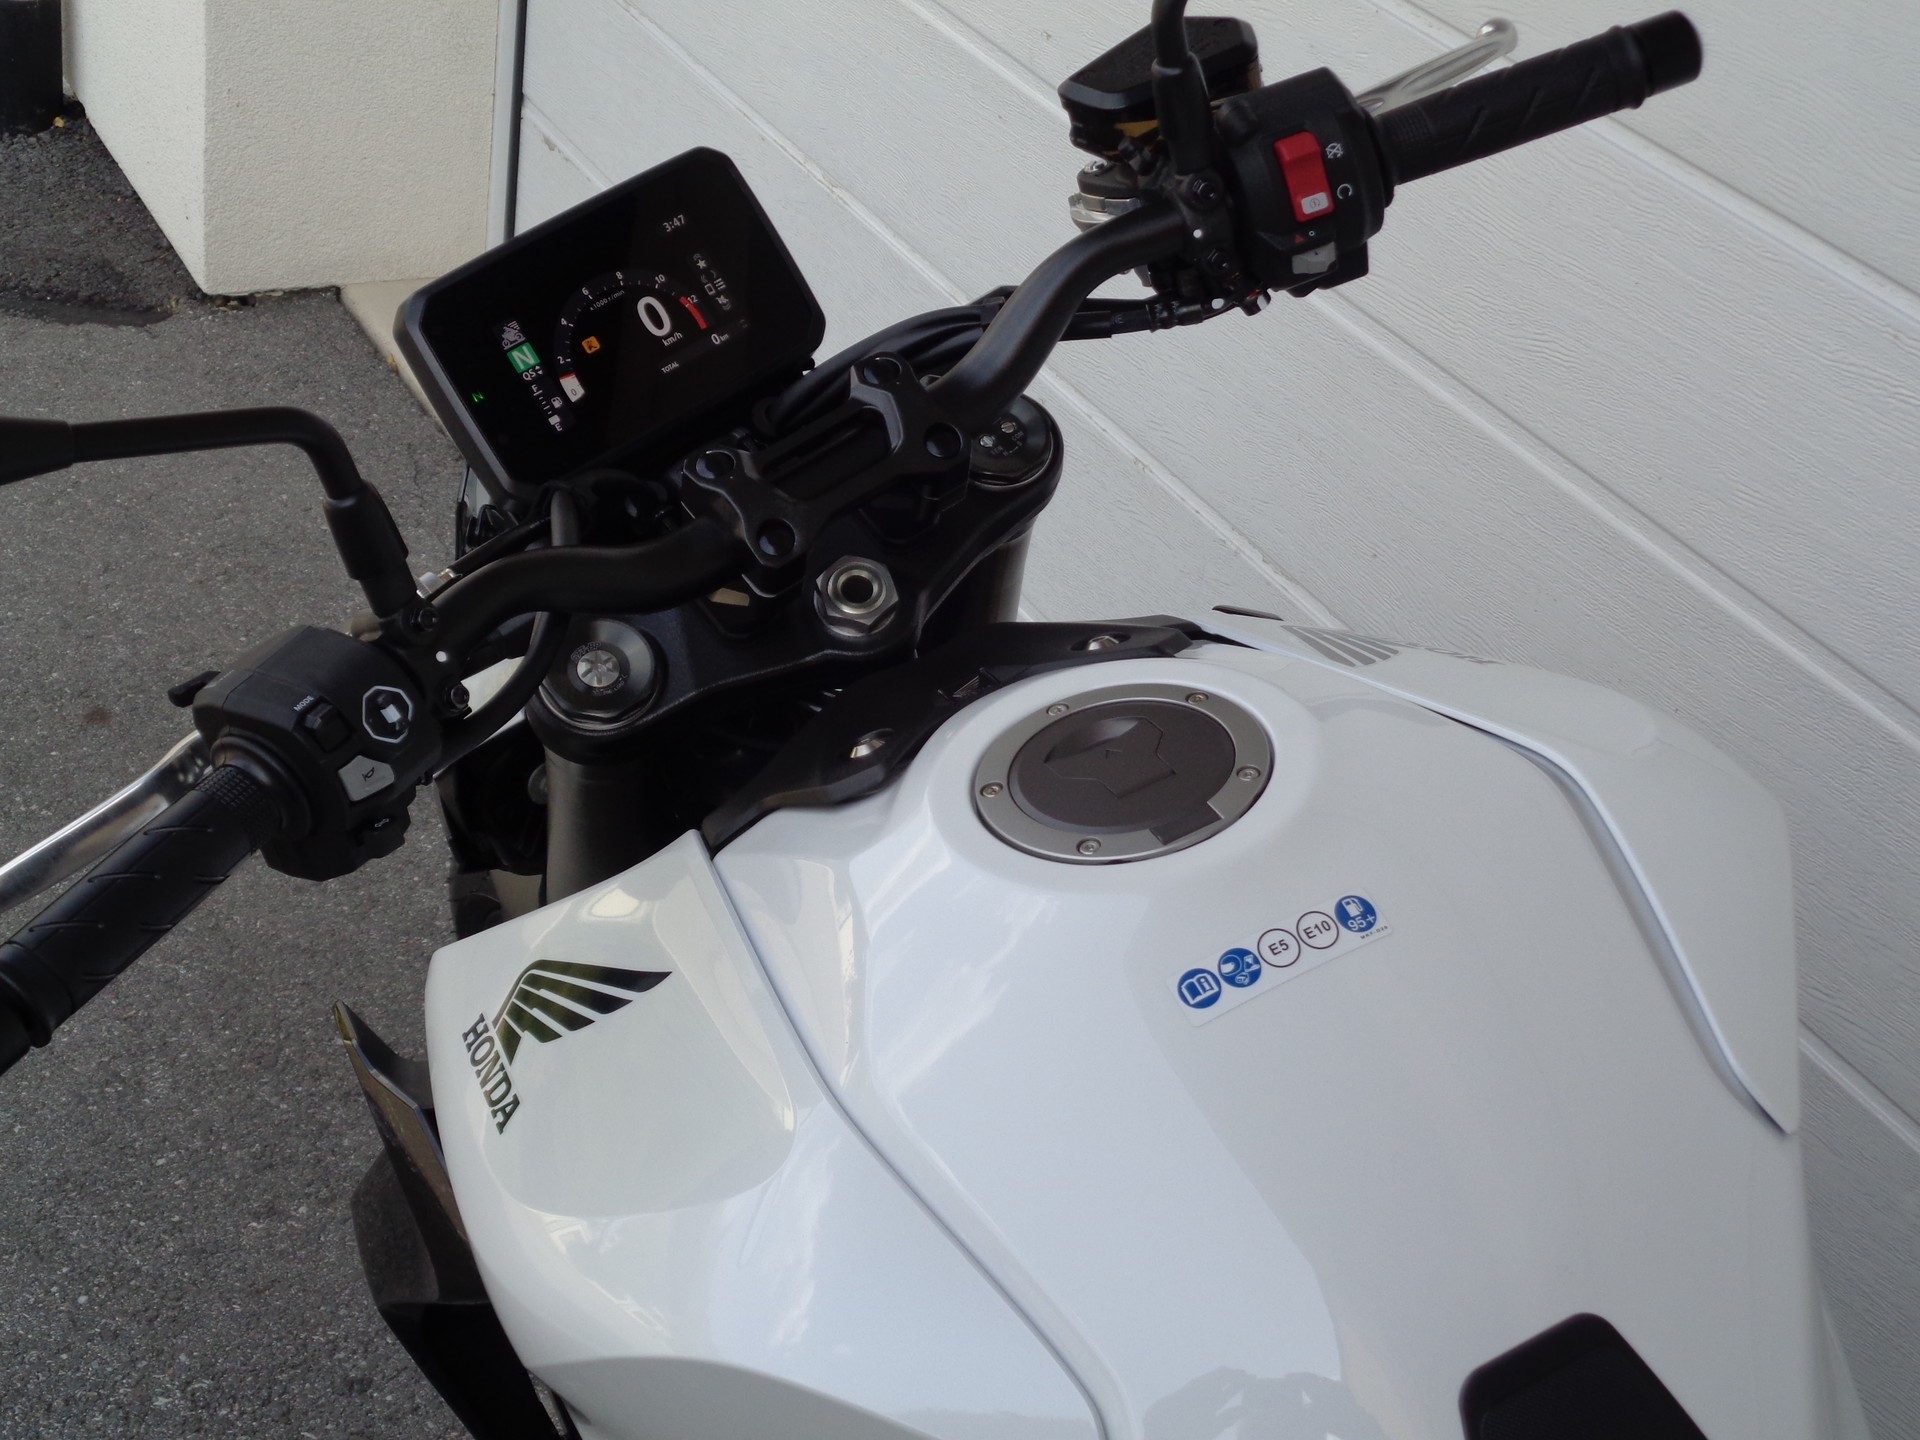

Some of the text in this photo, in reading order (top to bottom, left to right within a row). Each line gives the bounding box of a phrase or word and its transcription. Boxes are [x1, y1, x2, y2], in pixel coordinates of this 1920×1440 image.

[663, 214, 685, 232] 3:47
[615, 271, 623, 280] 8
[655, 274, 666, 284] 10
[582, 287, 589, 296] 6
[687, 294, 698, 304] 12
[561, 317, 568, 326] 4
[637, 295, 671, 337] 0
[662, 331, 683, 347] km/h
[711, 333, 721, 345] 0
[511, 345, 535, 371] N
[557, 356, 565, 364] 2
[661, 361, 679, 374] TOTAL
[522, 368, 537, 381] QS
[531, 384, 539, 393] F
[471, 391, 484, 403] N
[554, 422, 563, 432] E
[293, 695, 314, 711] MODE
[1347, 914, 1375, 931] 95+
[1303, 920, 1331, 940] E10
[1268, 938, 1289, 956] E5
[462, 1012, 521, 1135] HONDA
